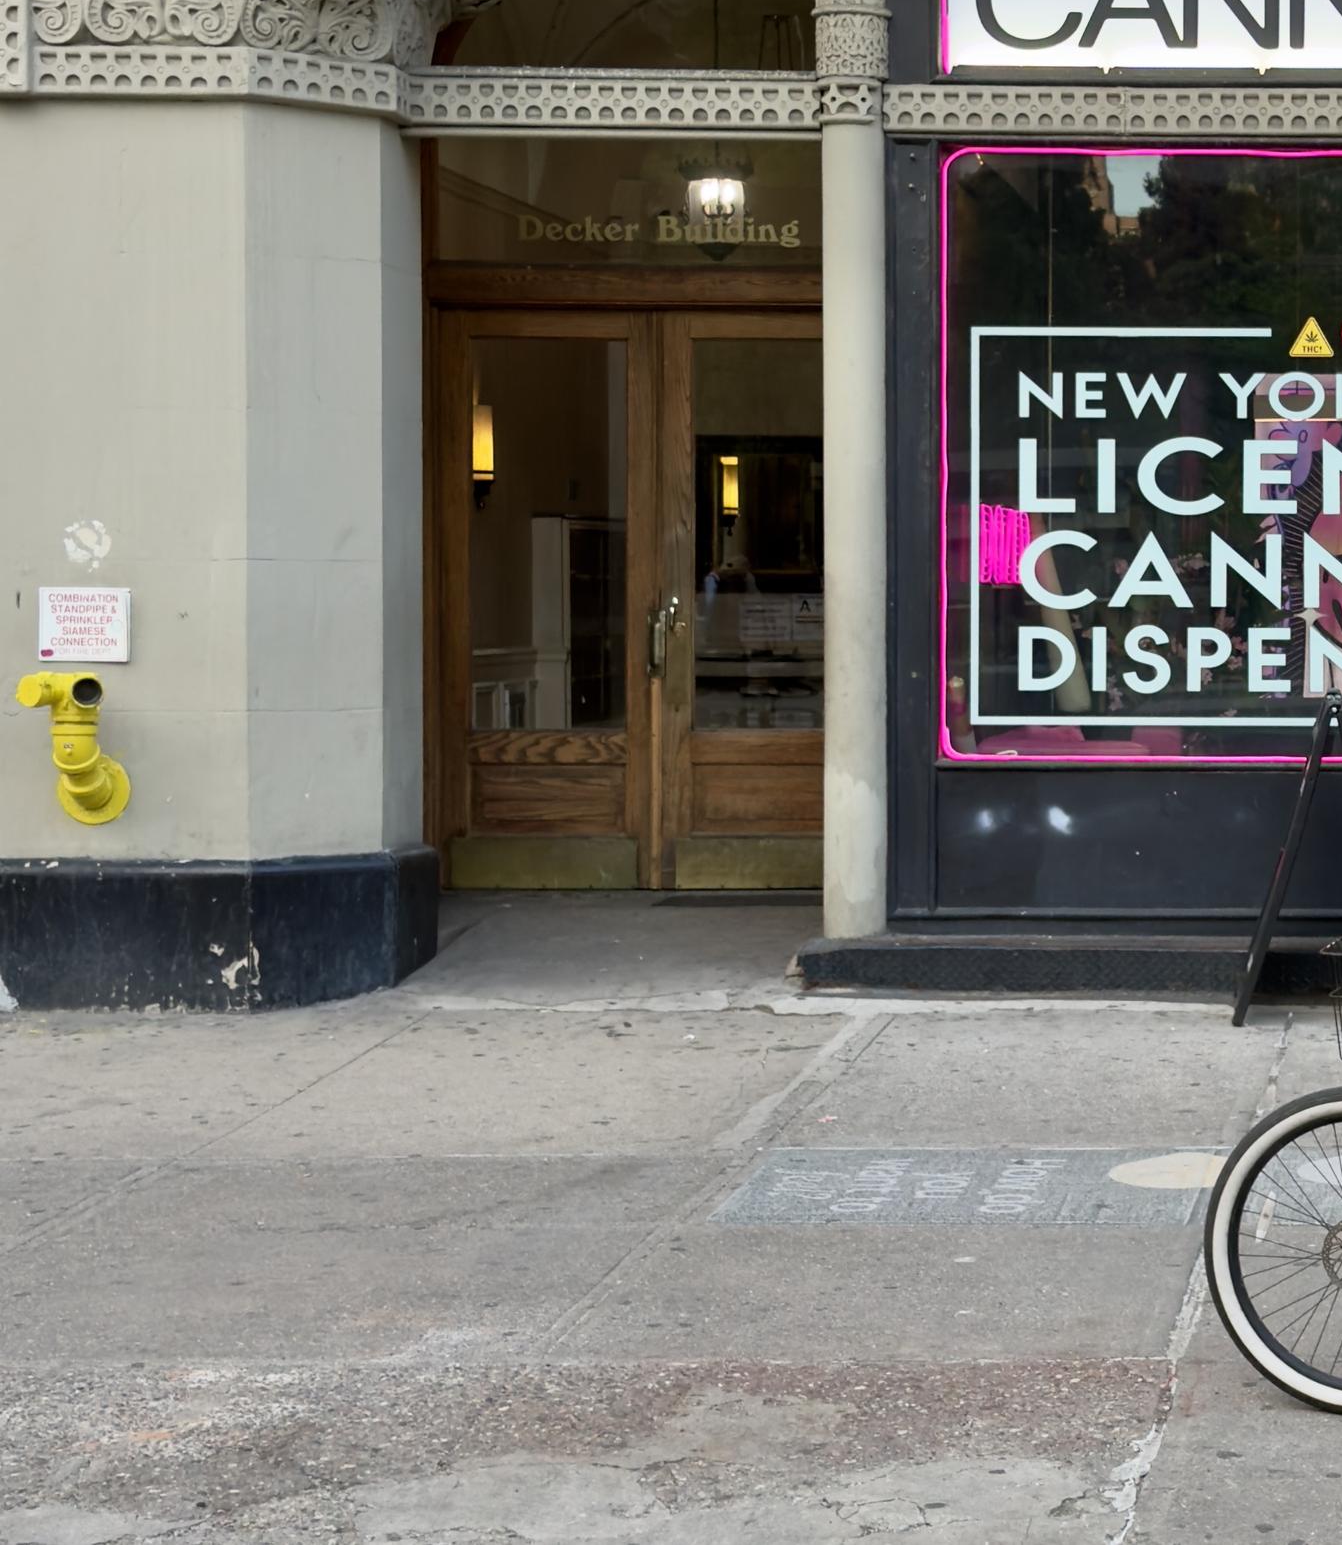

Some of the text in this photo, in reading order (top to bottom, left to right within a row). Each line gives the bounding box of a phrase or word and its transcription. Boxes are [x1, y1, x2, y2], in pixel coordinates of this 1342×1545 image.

[516, 214, 801, 248] Decker Building
[1017, 371, 1188, 422] NEW
[48, 593, 119, 603] COMBINATION
[50, 604, 117, 614] STANDPIPE &
[55, 615, 113, 625] SPRINKLER
[62, 626, 107, 636] SIAMESE
[50, 637, 118, 647] CONNECTION
[829, 1158, 914, 1213] want to
[912, 1171, 976, 1199] you
[978, 1158, 1067, 1214] How do
